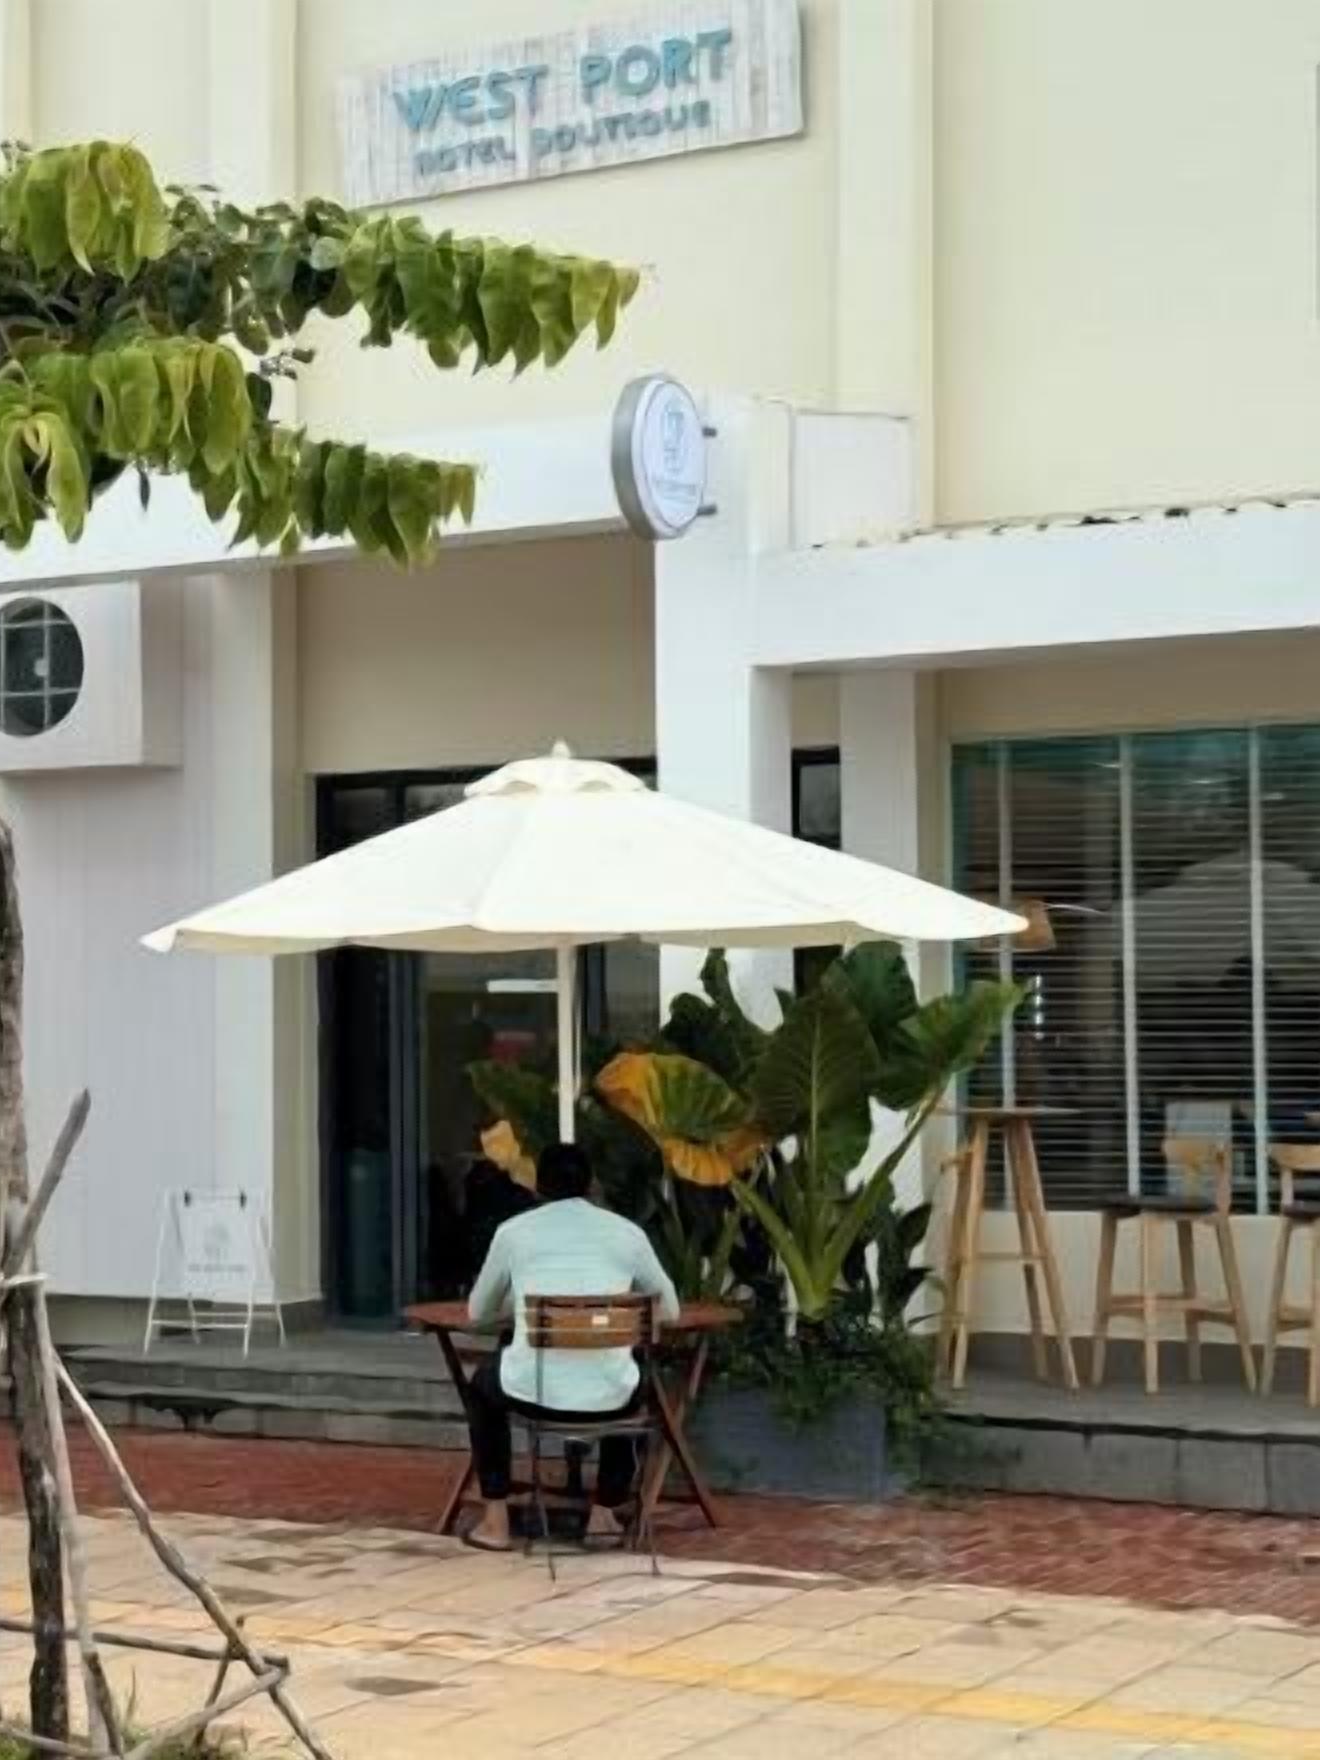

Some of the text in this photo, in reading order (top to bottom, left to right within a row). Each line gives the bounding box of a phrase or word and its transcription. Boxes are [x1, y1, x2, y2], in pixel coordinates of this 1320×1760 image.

[393, 28, 733, 132] WEST PORT
[413, 101, 711, 177] HOTEL BOUTIQUE
